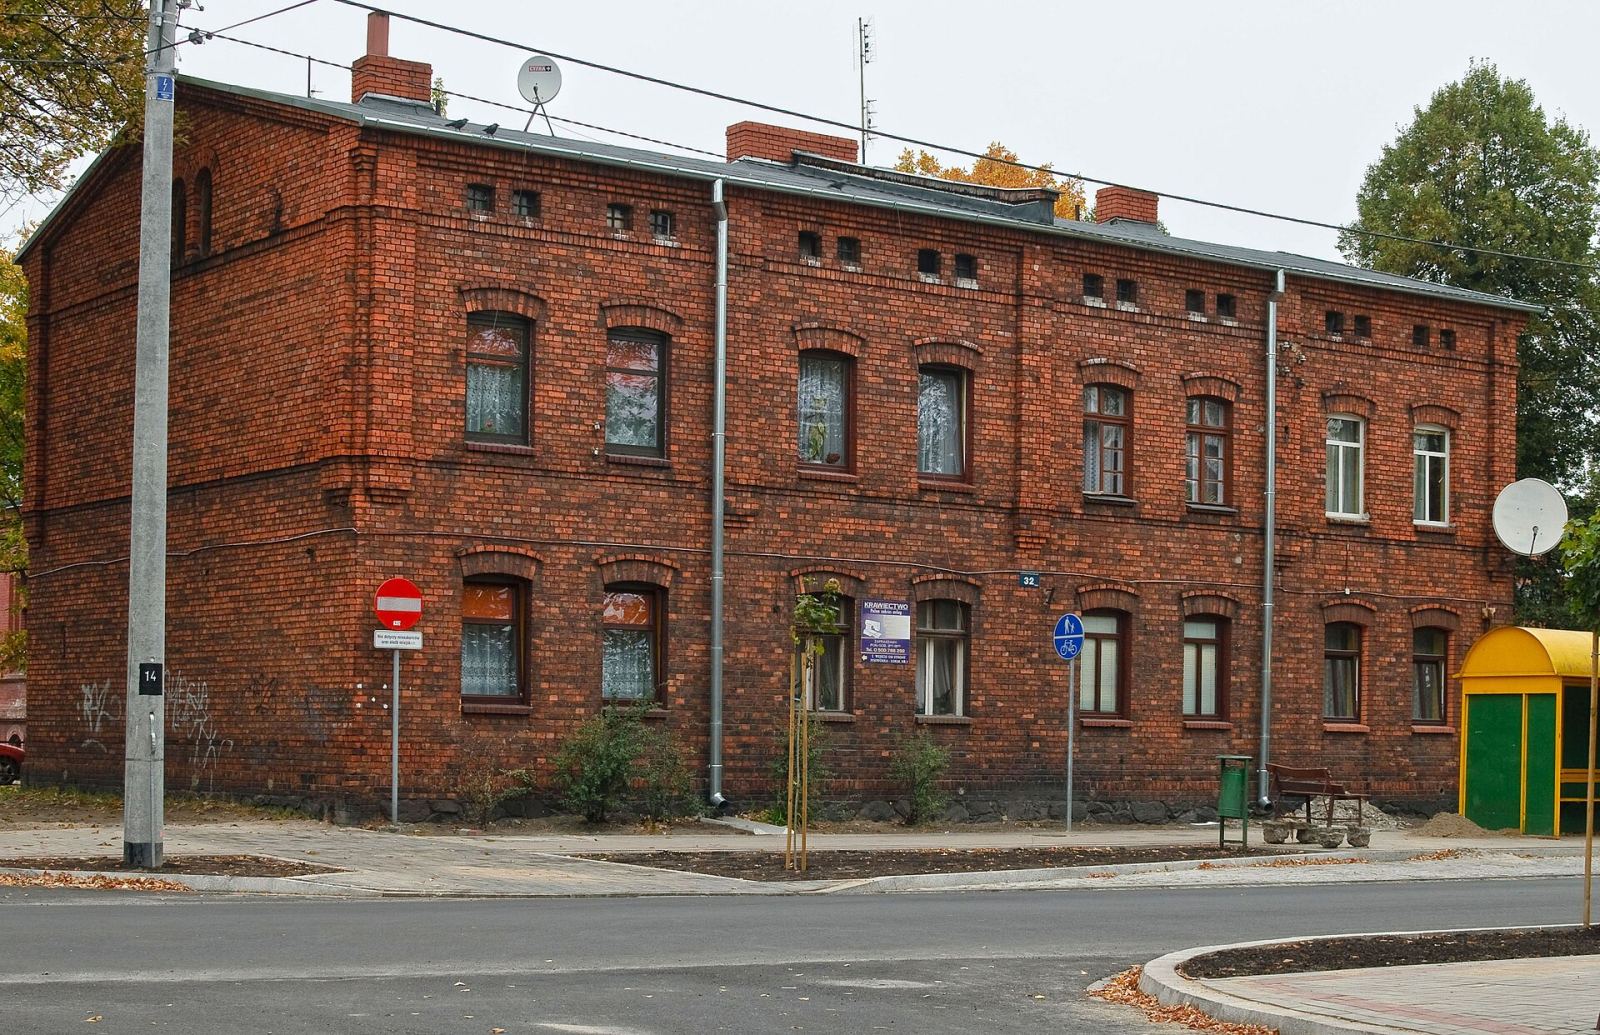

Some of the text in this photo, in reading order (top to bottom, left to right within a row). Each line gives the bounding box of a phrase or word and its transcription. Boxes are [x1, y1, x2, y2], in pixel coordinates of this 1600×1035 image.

[1023, 576, 1035, 586] 32
[864, 601, 909, 610] KRAWIECTWO
[144, 670, 157, 682] 14
